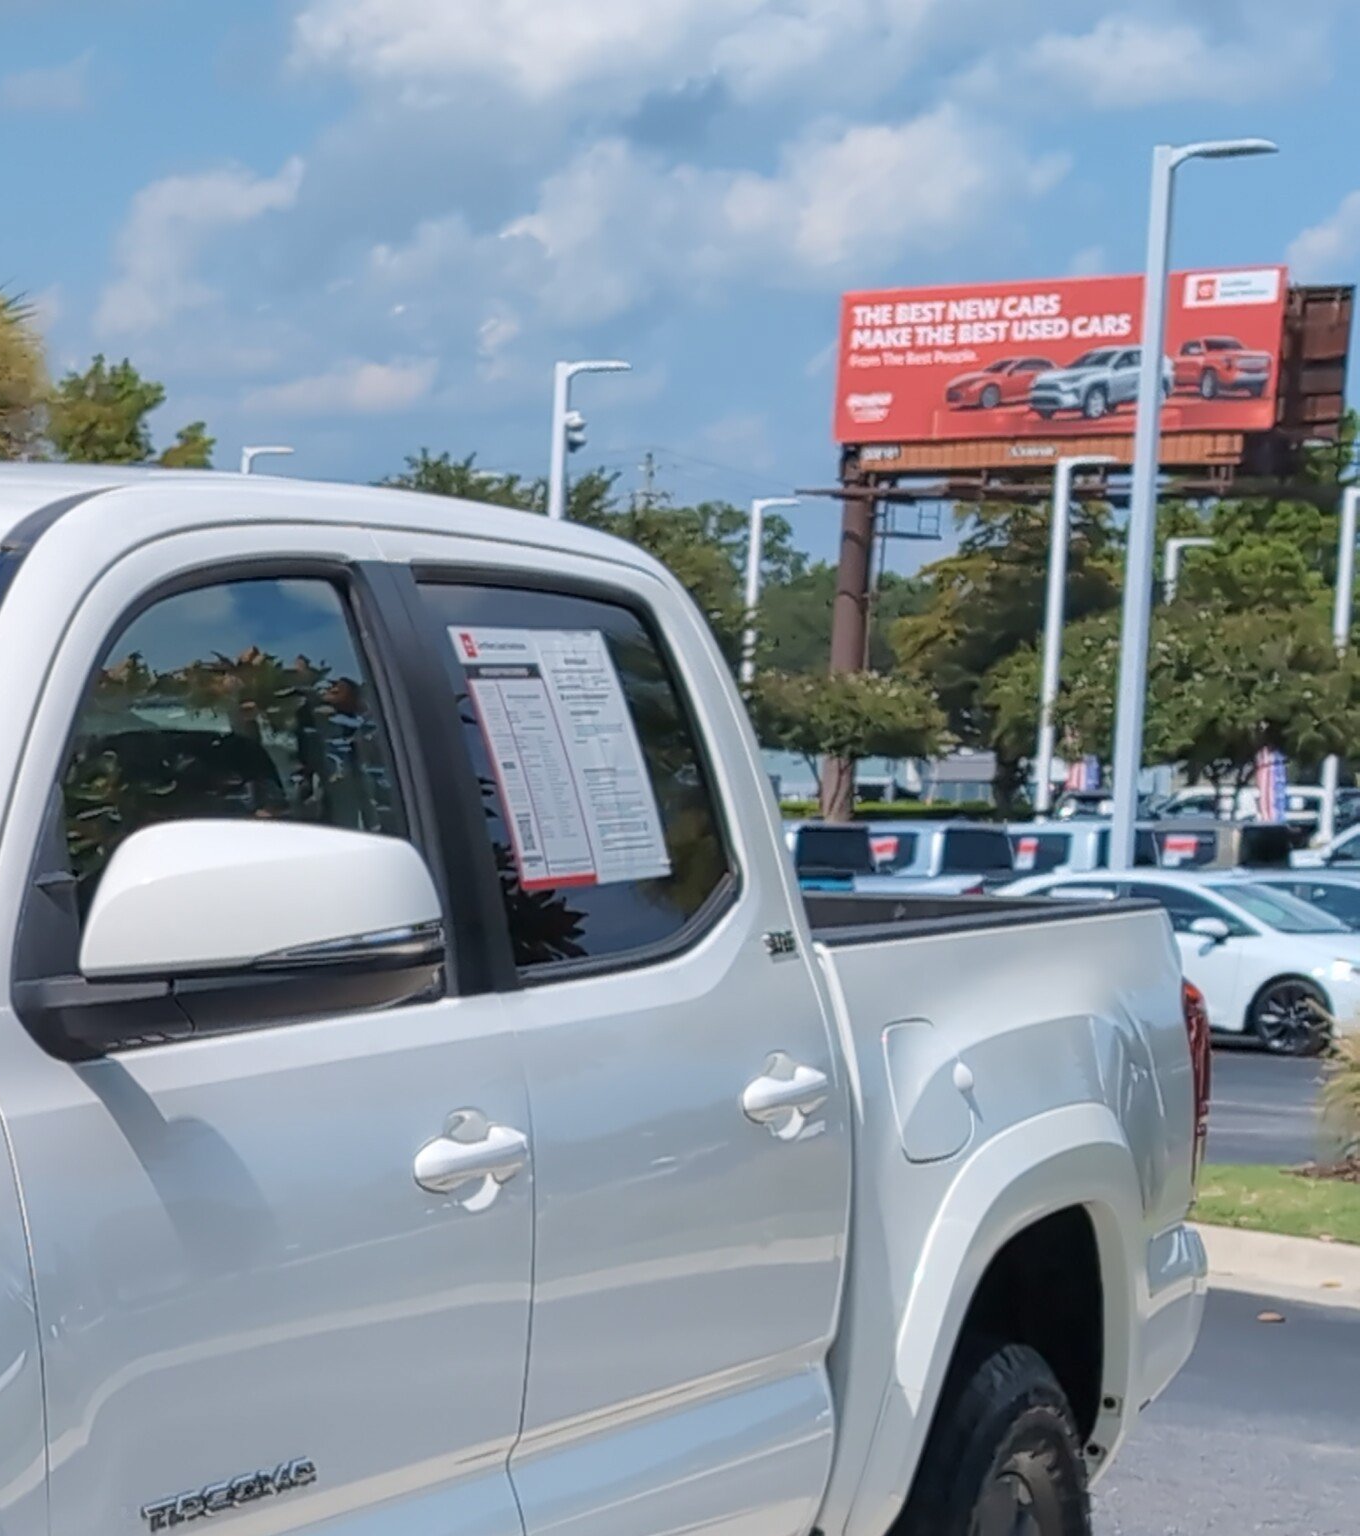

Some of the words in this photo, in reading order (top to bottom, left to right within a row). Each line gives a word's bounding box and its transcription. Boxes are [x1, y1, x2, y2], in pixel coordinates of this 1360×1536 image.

[853, 304, 894, 326] THE
[894, 301, 946, 324] BEST
[946, 297, 1000, 322] NEW
[1002, 293, 1061, 319] CARS
[849, 327, 912, 350] MAKE
[914, 324, 955, 347] THE
[957, 320, 1010, 344] BEST
[1011, 317, 1070, 341] USED
[1071, 313, 1132, 339] CARS
